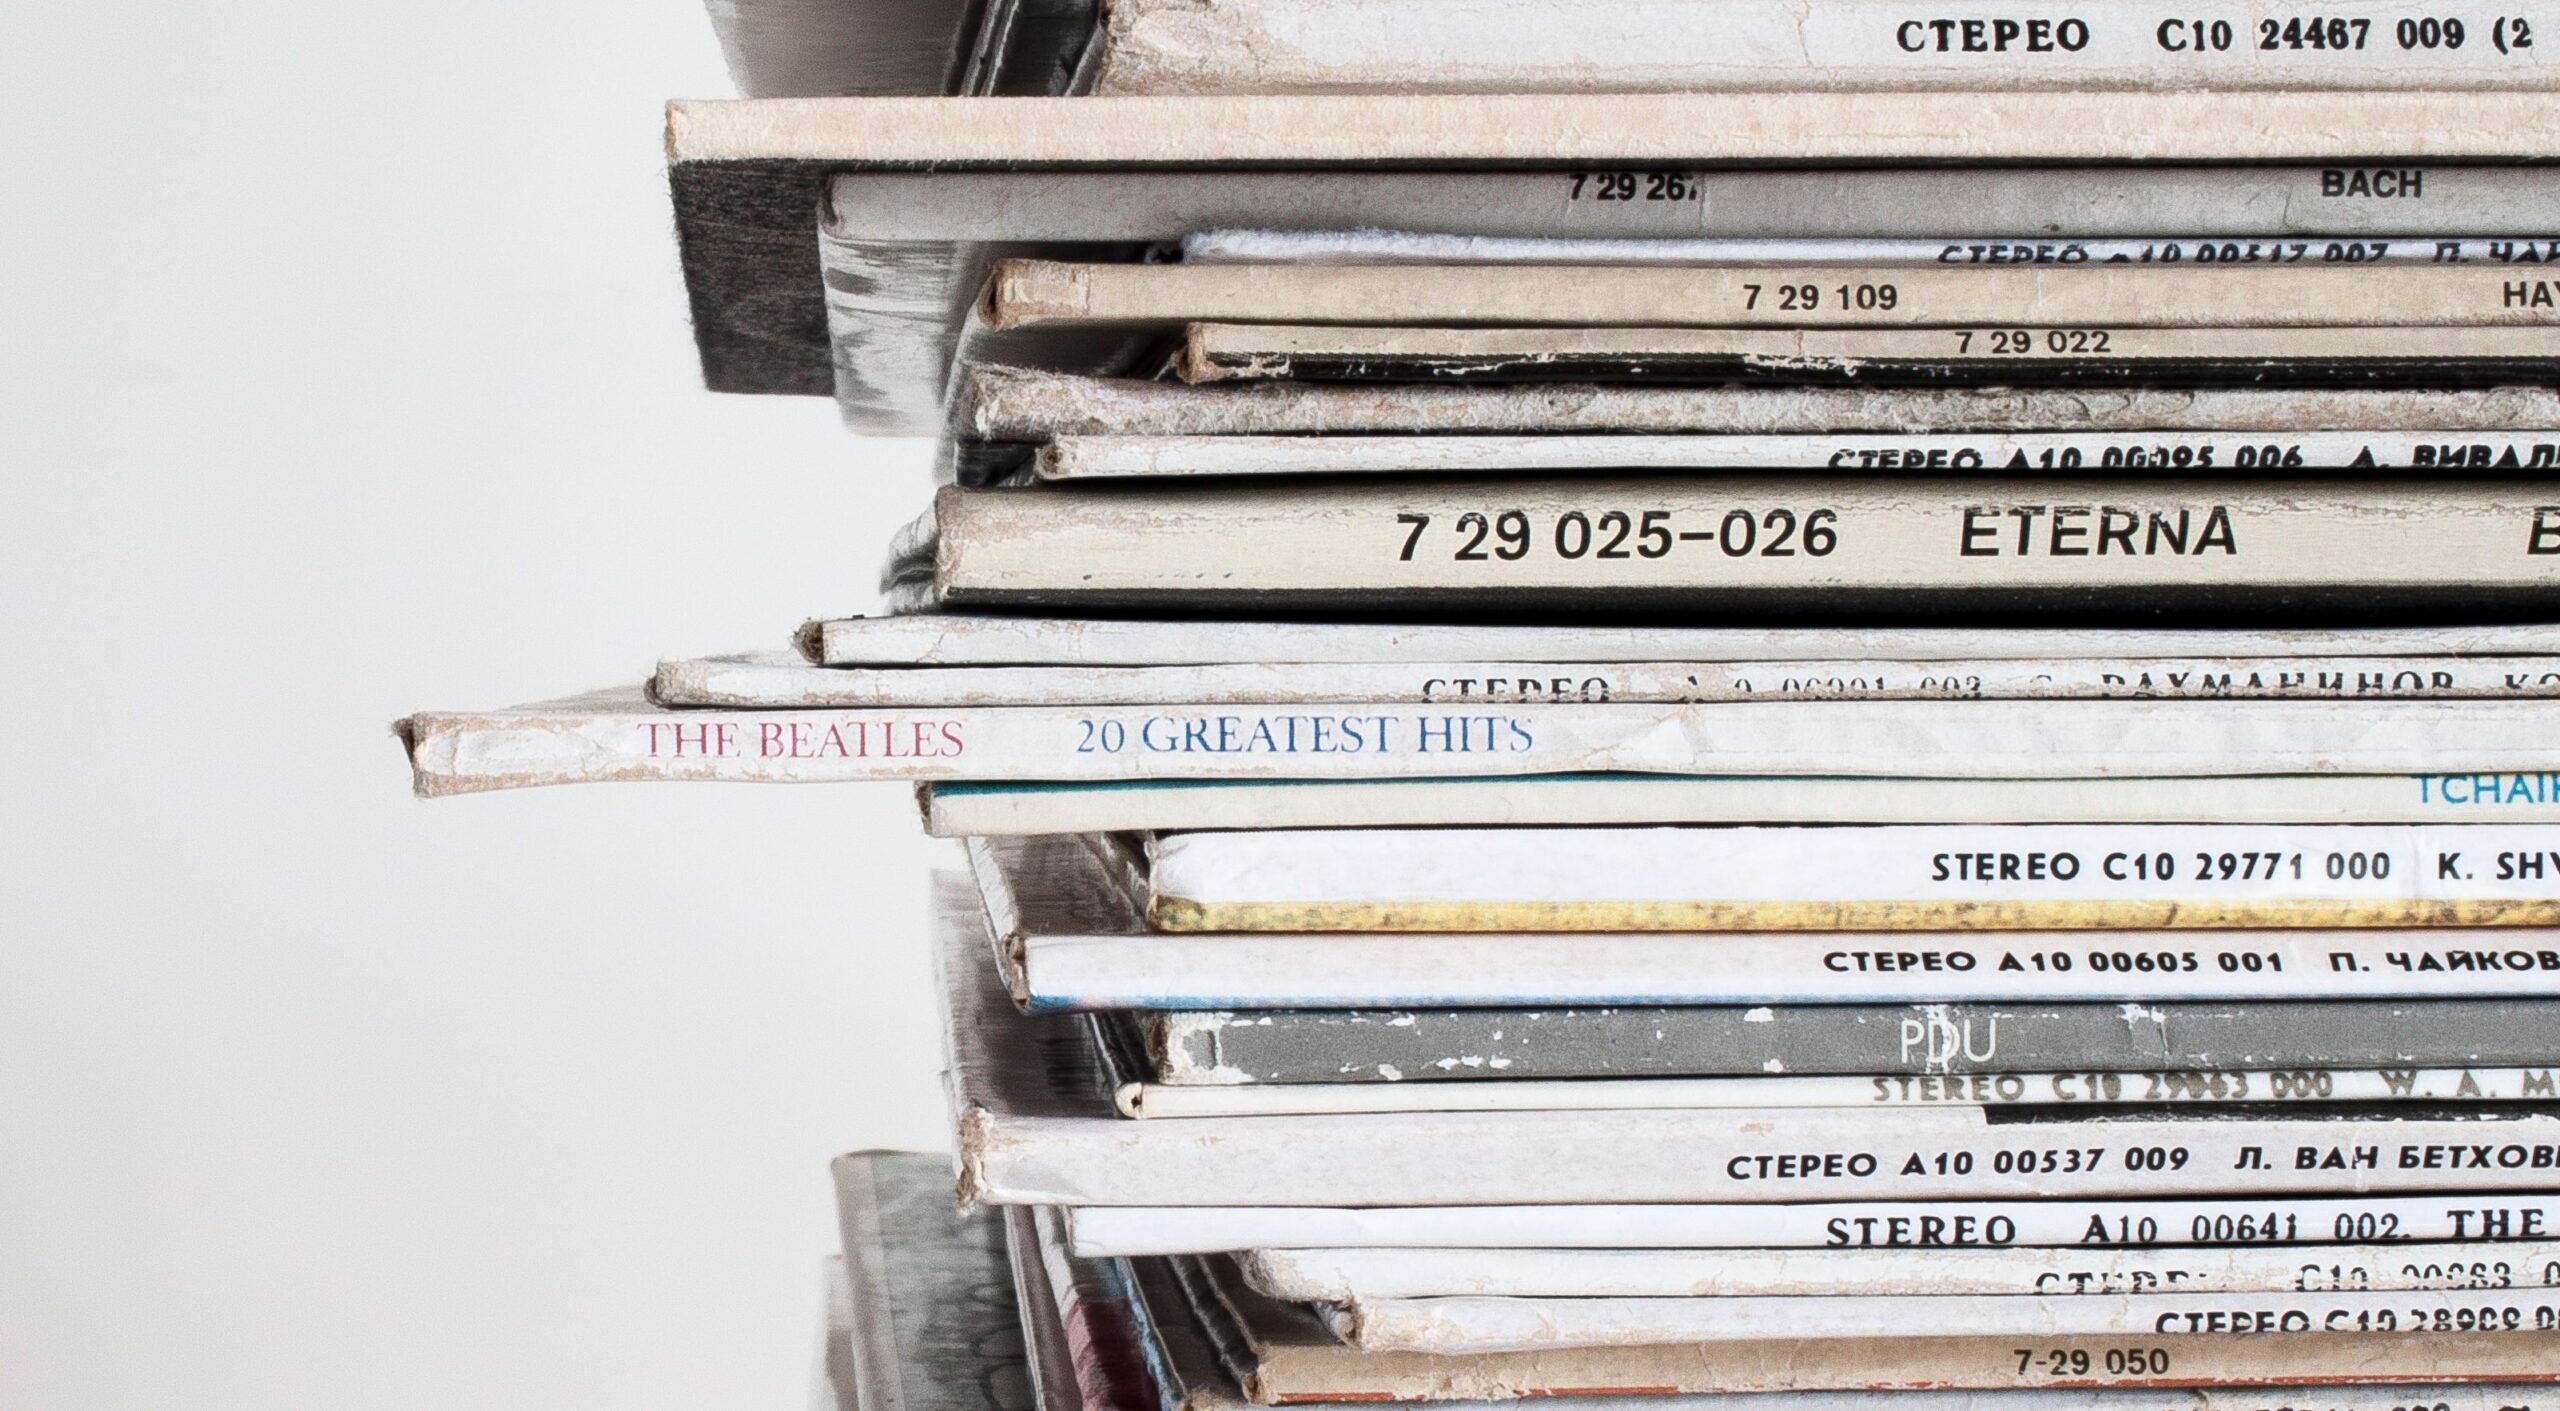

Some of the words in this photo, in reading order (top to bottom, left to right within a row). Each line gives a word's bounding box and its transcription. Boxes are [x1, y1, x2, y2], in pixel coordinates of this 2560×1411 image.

[1896, 18, 2090, 52] СТЕРЕО
[2157, 18, 2232, 51] С10
[2260, 17, 2371, 50] 24467
[2397, 17, 2465, 50] 009
[2492, 16, 2532, 55] (2
[1569, 173, 1588, 200] 7
[1597, 172, 1636, 201] 29
[2322, 169, 2422, 198] BACH
[1743, 284, 1761, 310] 7
[1779, 284, 1819, 310] 29
[1836, 284, 1898, 310] 109
[1955, 331, 1973, 354] 7
[1990, 331, 2031, 354] 29
[2046, 331, 2111, 353] 022
[2412, 444, 2560, 468] ВИВАЛ
[1396, 513, 1430, 561] 7
[1454, 510, 1531, 560] 29
[1960, 505, 2237, 557] ETERNA
[637, 721, 741, 759] THE
[760, 720, 965, 758] BEATLES
[1076, 718, 1126, 753] 20
[1142, 716, 1398, 753] GREATEST
[1416, 716, 1535, 753] HITS
[1931, 852, 2080, 881] STEREO
[2103, 852, 2175, 881] C10
[2195, 852, 2302, 881] 29771
[2326, 852, 2391, 881] 000
[2438, 852, 2473, 880] K.
[1823, 951, 1977, 972] СТЕРЕО
[1998, 951, 2072, 972] А10
[2089, 951, 2198, 972] 00605
[2218, 952, 2282, 972] 001
[2328, 952, 2370, 972] П.
[1900, 1017, 1996, 1064] PDU
[1873, 1076, 2025, 1101] STEREO
[2052, 1074, 2121, 1101] C10
[2455, 1069, 2497, 1097] A.
[1726, 1152, 1877, 1180] СТЕРЕО
[1900, 1151, 1974, 1176] А10
[1992, 1149, 2105, 1174] 00537
[2124, 1147, 2189, 1172] 009
[2234, 1147, 2272, 1169] Л.
[2295, 1146, 2379, 1170] ВАН
[2398, 1145, 2560, 1169] БЕТХОВ
[1826, 1215, 2016, 1246] STEREO
[2081, 1214, 2158, 1244] A10
[2191, 1212, 2297, 1241] 00641
[2447, 1209, 2546, 1237] THE
[2013, 1349, 2090, 1375] 7-29
[2105, 1348, 2170, 1375] 050
